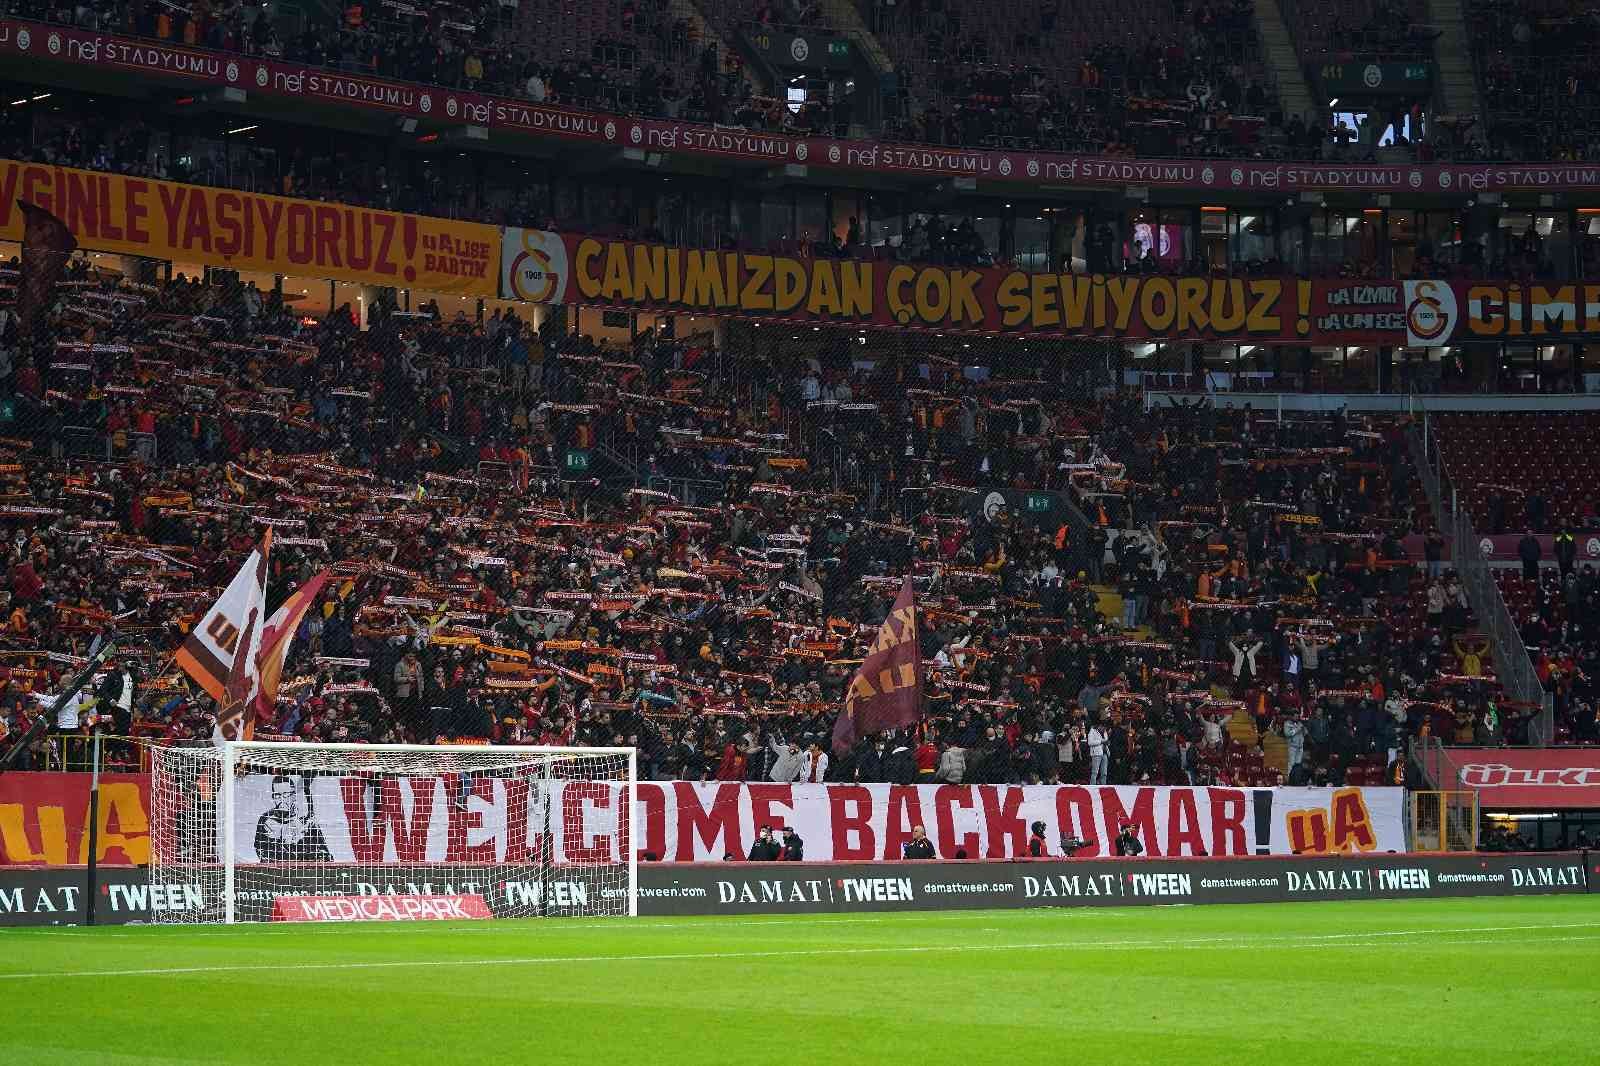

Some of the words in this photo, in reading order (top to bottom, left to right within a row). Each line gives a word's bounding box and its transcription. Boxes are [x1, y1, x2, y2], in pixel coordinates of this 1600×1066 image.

[67, 37, 102, 60] nef
[105, 45, 219, 75] STADYUMU
[274, 70, 305, 92] nef
[309, 77, 414, 107] STADYUMU
[463, 99, 494, 122] nef
[496, 105, 600, 133] STADYUMU
[648, 125, 678, 147] nef
[683, 128, 789, 155] STADYUMU
[847, 145, 878, 166] nef
[882, 151, 991, 170] STADYUMU
[1046, 158, 1077, 179] nef
[1082, 161, 1195, 180] STADYUMU
[1250, 167, 1281, 187] nef
[1287, 170, 1401, 186] STADYUMU
[1458, 168, 1492, 189] nef
[575, 238, 873, 317] CANIMIZDAN
[886, 265, 985, 325] ÇOK
[339, 777, 795, 865] WELCOME
[826, 785, 1027, 861] BACK
[1055, 785, 1274, 857] OMAR!
[108, 884, 205, 912] TWEEN
[716, 879, 821, 905] DAMAT
[841, 877, 914, 902] TWEEN
[923, 879, 1014, 894] damattween.com
[1023, 874, 1115, 899] DAMAT
[1131, 872, 1192, 896] TWEEN
[1200, 876, 1279, 889] damattween.com
[1286, 869, 1364, 892] DAMAT
[1378, 867, 1430, 891] TWEEN
[1437, 871, 1504, 884] damattween.com
[1510, 866, 1578, 887] DAMAT
[299, 897, 399, 920] MEDICAL
[400, 897, 471, 920] PARK
